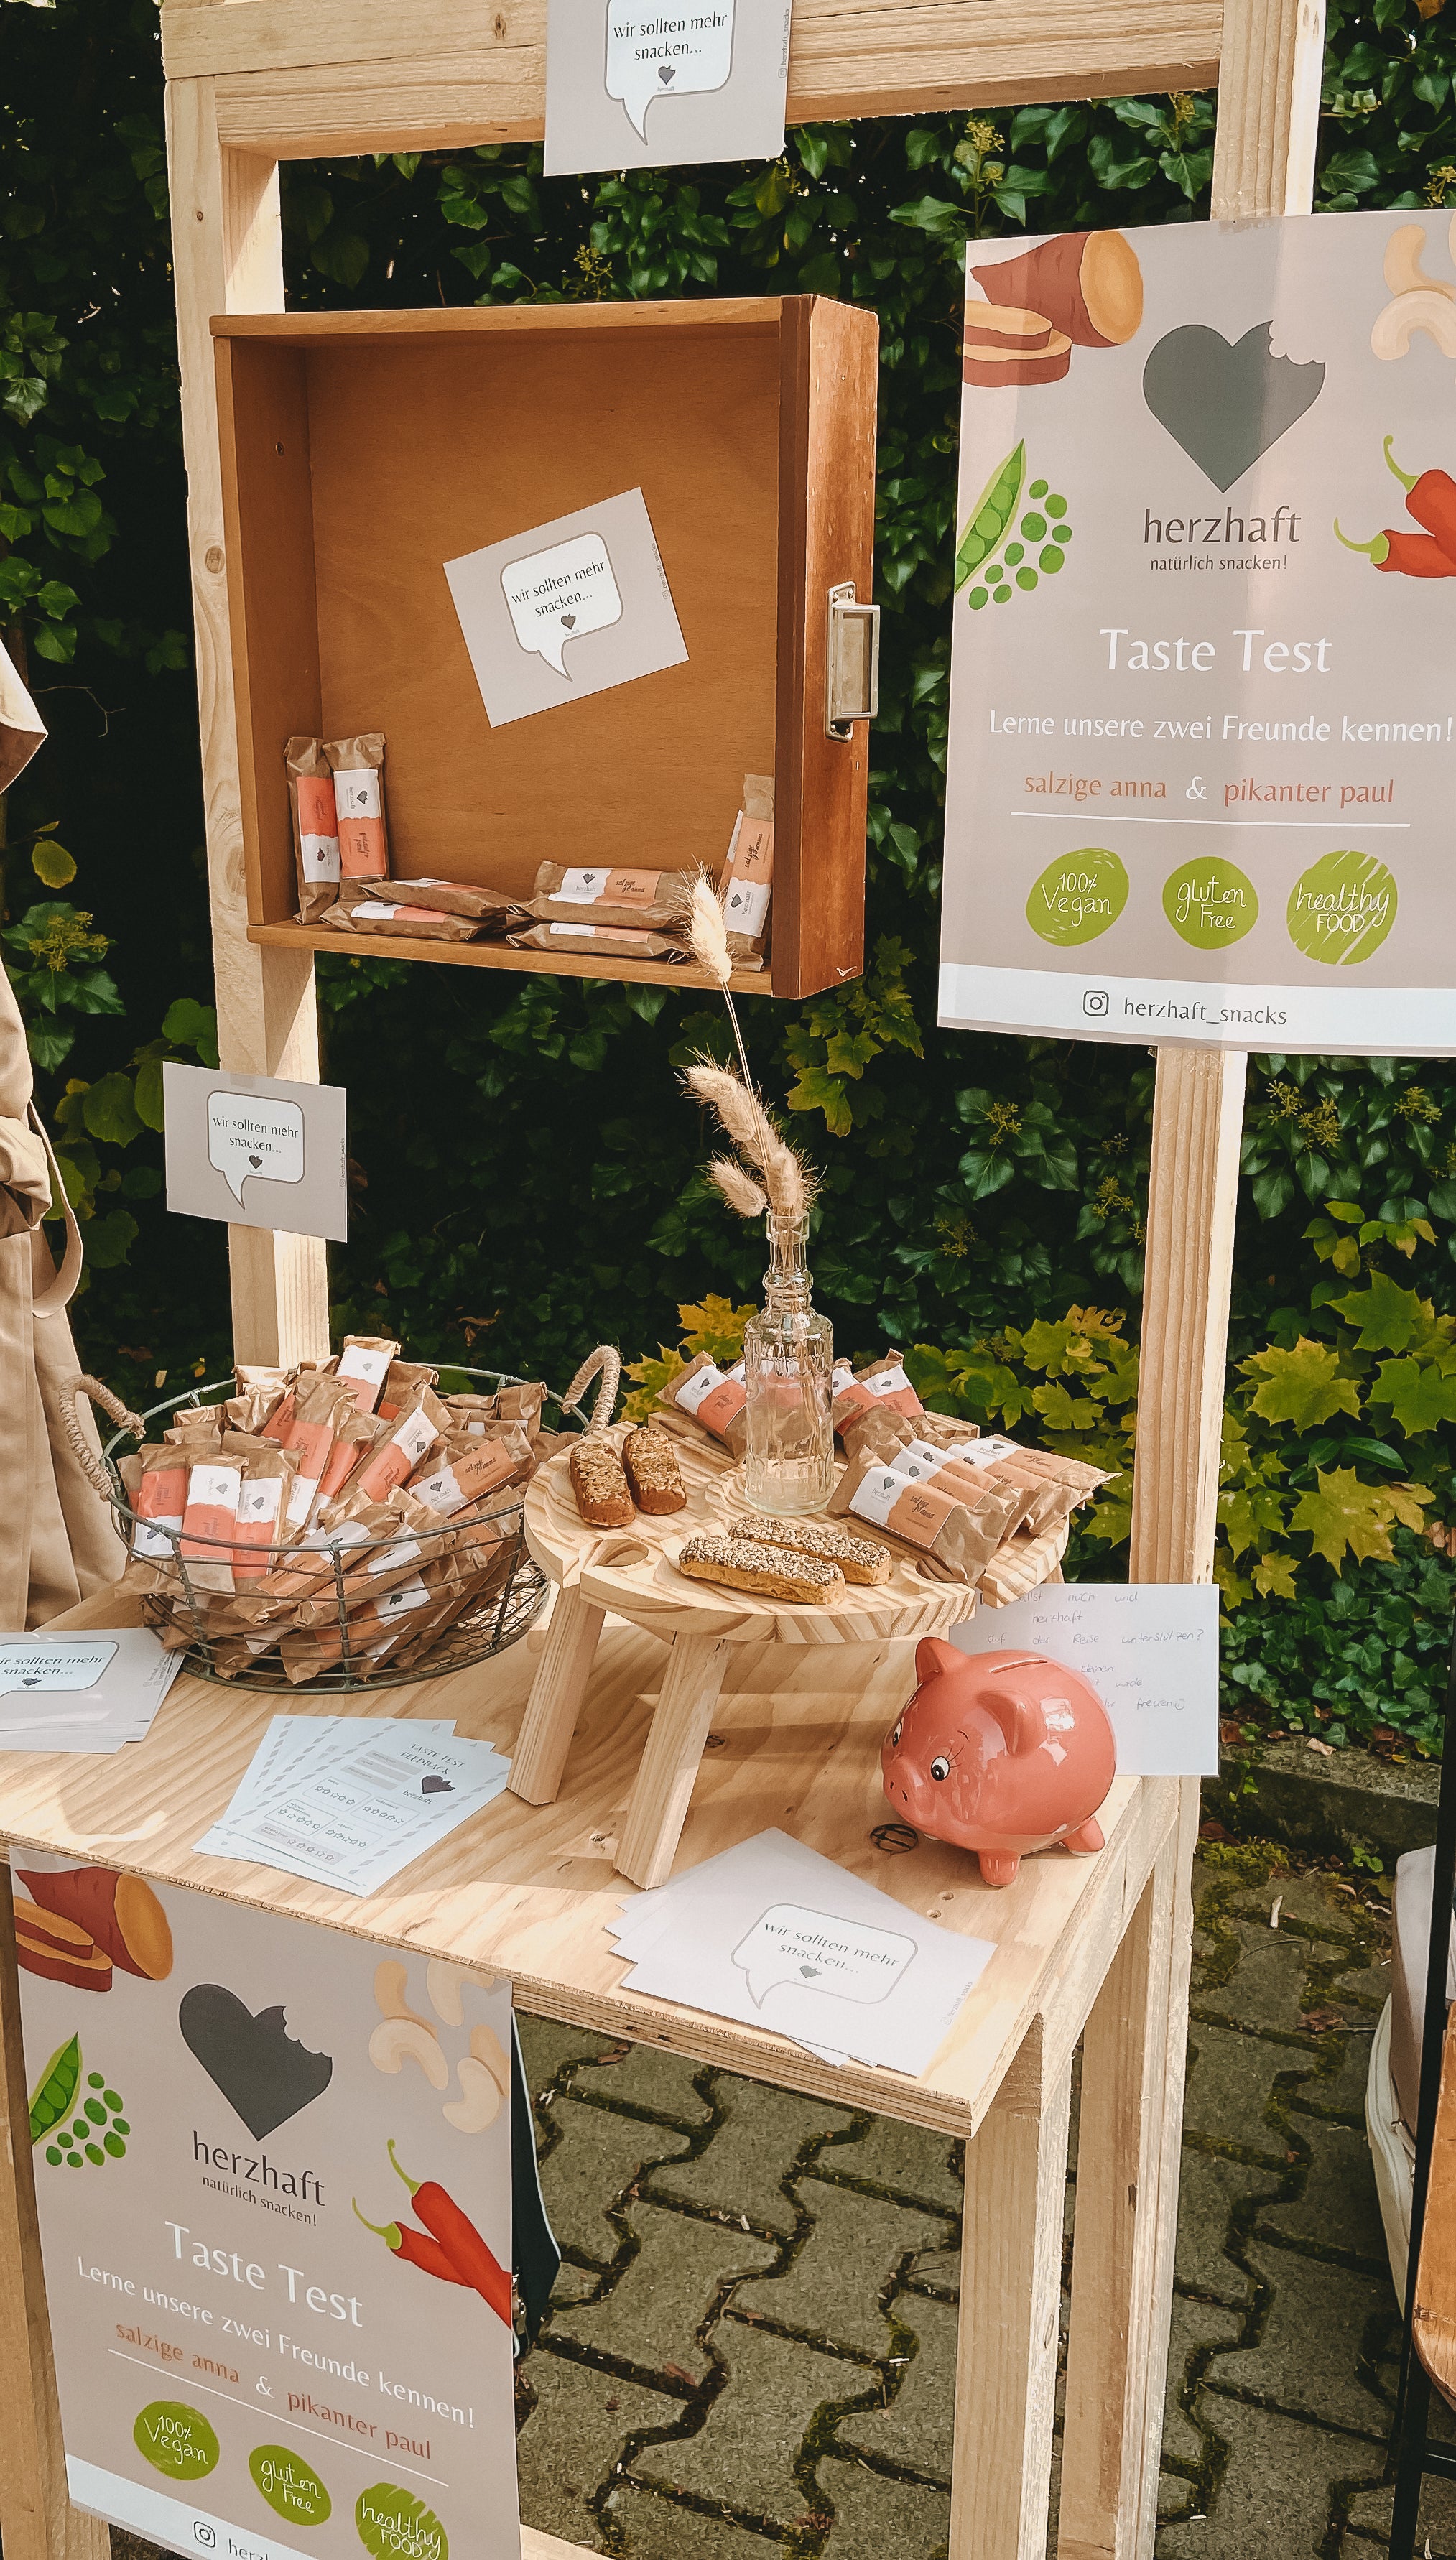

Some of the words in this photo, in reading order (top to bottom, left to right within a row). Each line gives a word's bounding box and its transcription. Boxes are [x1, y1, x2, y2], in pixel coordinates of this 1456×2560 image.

[613, 22, 636, 38] wir
[640, 18, 685, 37] sollten
[690, 11, 728, 29] mehr
[634, 41, 702, 60] snacken...
[1144, 506, 1302, 544] herzhaft
[1150, 555, 1214, 570] natürlich
[1219, 555, 1287, 570] snacken!
[511, 588, 530, 604] wir
[533, 575, 572, 597] sollten
[575, 560, 605, 581] mehr
[535, 590, 593, 618] snacken...
[1100, 629, 1215, 671] Taste
[1233, 629, 1332, 672] Test
[990, 710, 1055, 736] Lerne
[1064, 716, 1143, 738] unsere
[1154, 715, 1211, 739] zwei
[1223, 715, 1331, 741] Freunde
[1342, 716, 1452, 741] kennen!
[1024, 771, 1101, 801] salzige
[1110, 779, 1167, 799] anna
[1185, 776, 1207, 800] &
[1224, 777, 1331, 807] pikanter
[1340, 779, 1394, 808] paul
[1059, 872, 1098, 893] 100%
[1042, 884, 1112, 926] Vegan
[1176, 876, 1246, 922] gluten
[1296, 883, 1390, 927] healthy
[1200, 904, 1236, 929] Free
[1317, 914, 1365, 932] FOOD
[1124, 997, 1286, 1025] herzhaft_snacks
[213, 1116, 230, 1128] wir
[232, 1119, 267, 1133] sollten
[272, 1126, 298, 1138] mehr
[229, 1137, 282, 1154] snacken...
[1115, 1591, 1138, 1603] und
[1033, 1610, 1083, 1623] herzhaft
[988, 1632, 1007, 1644] auf
[1033, 1633, 1050, 1645] der
[1073, 1633, 1099, 1644] Reise
[67, 1655, 105, 1664] mehr
[400, 1752, 450, 1775] FEEDBACK
[410, 1743, 440, 1758] TASTE
[441, 1755, 465, 1768] TEST
[402, 1789, 433, 1804] herzhaft
[765, 1922, 792, 1937] wir
[793, 1931, 848, 1953] sollten
[854, 1948, 899, 1967] mehr
[778, 1943, 859, 1974] snacken...
[193, 2130, 325, 2207] herzhaft
[202, 2175, 257, 2204] natürlich
[260, 2194, 317, 2227] snacken!
[164, 2220, 265, 2291] Taste
[278, 2263, 363, 2327] Test
[78, 2255, 136, 2296] Lerne
[143, 2283, 213, 2325] unsere
[221, 2314, 271, 2350] zwei
[279, 2333, 370, 2388] Freunde
[379, 2372, 474, 2429] kennen!
[116, 2321, 183, 2362] salzige
[191, 2350, 240, 2385] anna
[255, 2375, 275, 2398] &
[287, 2392, 378, 2439] pikanter
[385, 2428, 432, 2461] paul
[144, 2418, 208, 2464] Vegan
[157, 2414, 193, 2441] 100%
[261, 2459, 322, 2499] gluten
[282, 2484, 315, 2514] Free
[362, 2497, 440, 2560] healthy
[381, 2528, 422, 2558] FOOD
